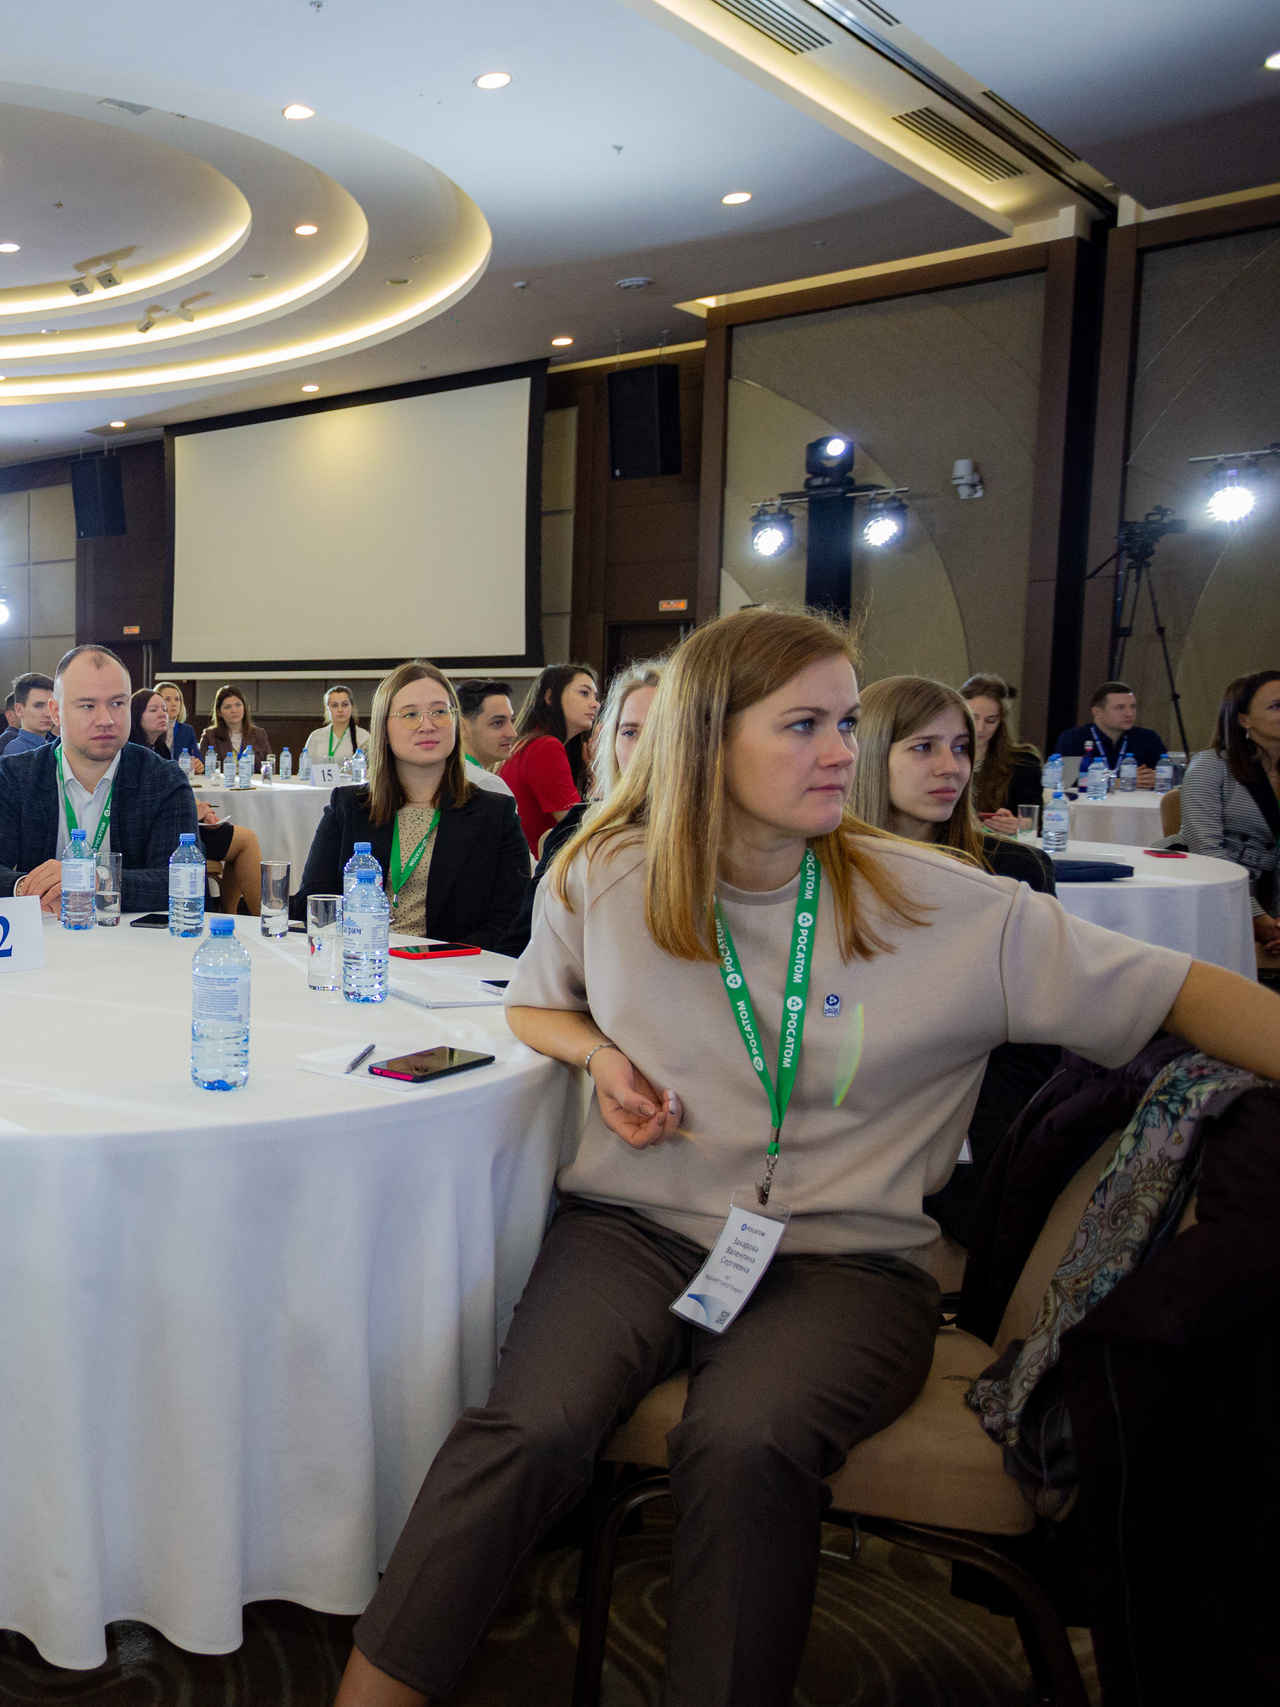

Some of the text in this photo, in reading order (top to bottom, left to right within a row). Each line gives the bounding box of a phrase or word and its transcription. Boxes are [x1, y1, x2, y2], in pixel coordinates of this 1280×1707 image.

[321, 769, 333, 782] 15
[94, 821, 106, 849] РОСАТОМ
[793, 928, 809, 984] РОСАТОМ
[736, 1000, 759, 1056] РОСАТОМ
[782, 1012, 798, 1068] РОСАТОМ
[725, 1246, 756, 1264] Валентина
[733, 1237, 760, 1253] Захарова
[720, 1256, 750, 1274] Сергеевна
